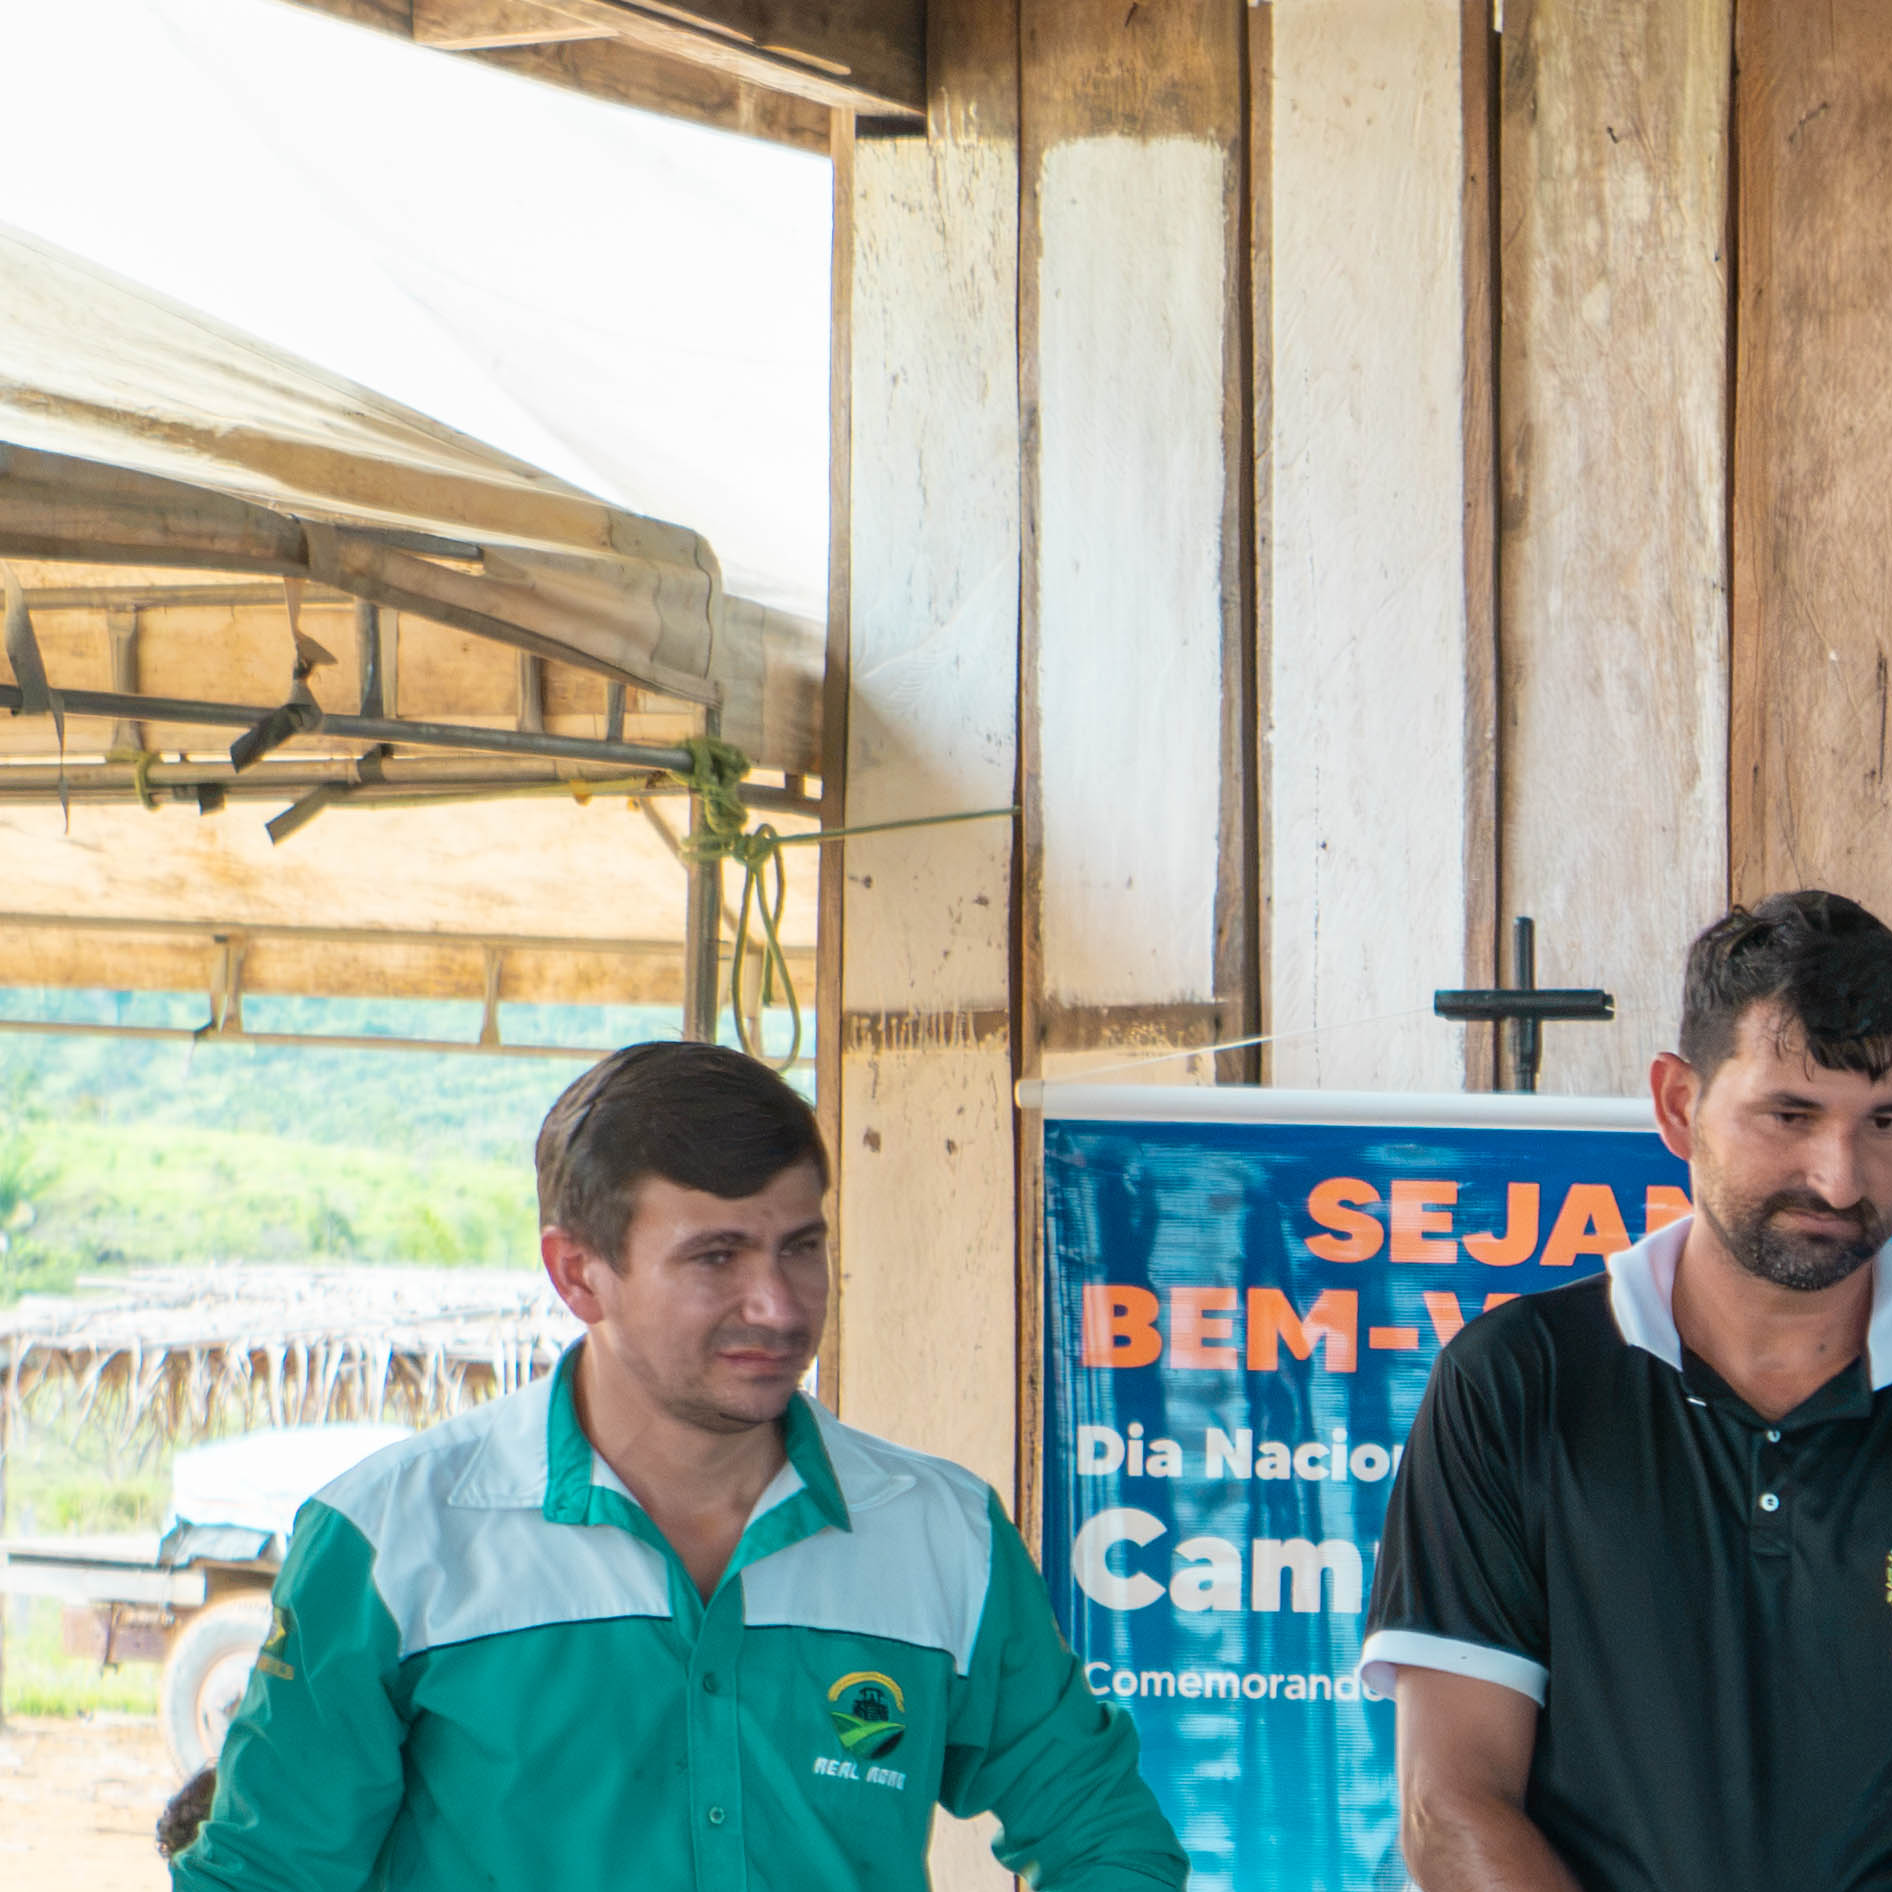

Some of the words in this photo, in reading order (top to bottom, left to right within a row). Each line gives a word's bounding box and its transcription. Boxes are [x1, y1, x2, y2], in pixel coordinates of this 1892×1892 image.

[1077, 1421, 1182, 1477] Dia
[1072, 1507, 1379, 1613] Cam
[813, 1757, 860, 1781] REAL
